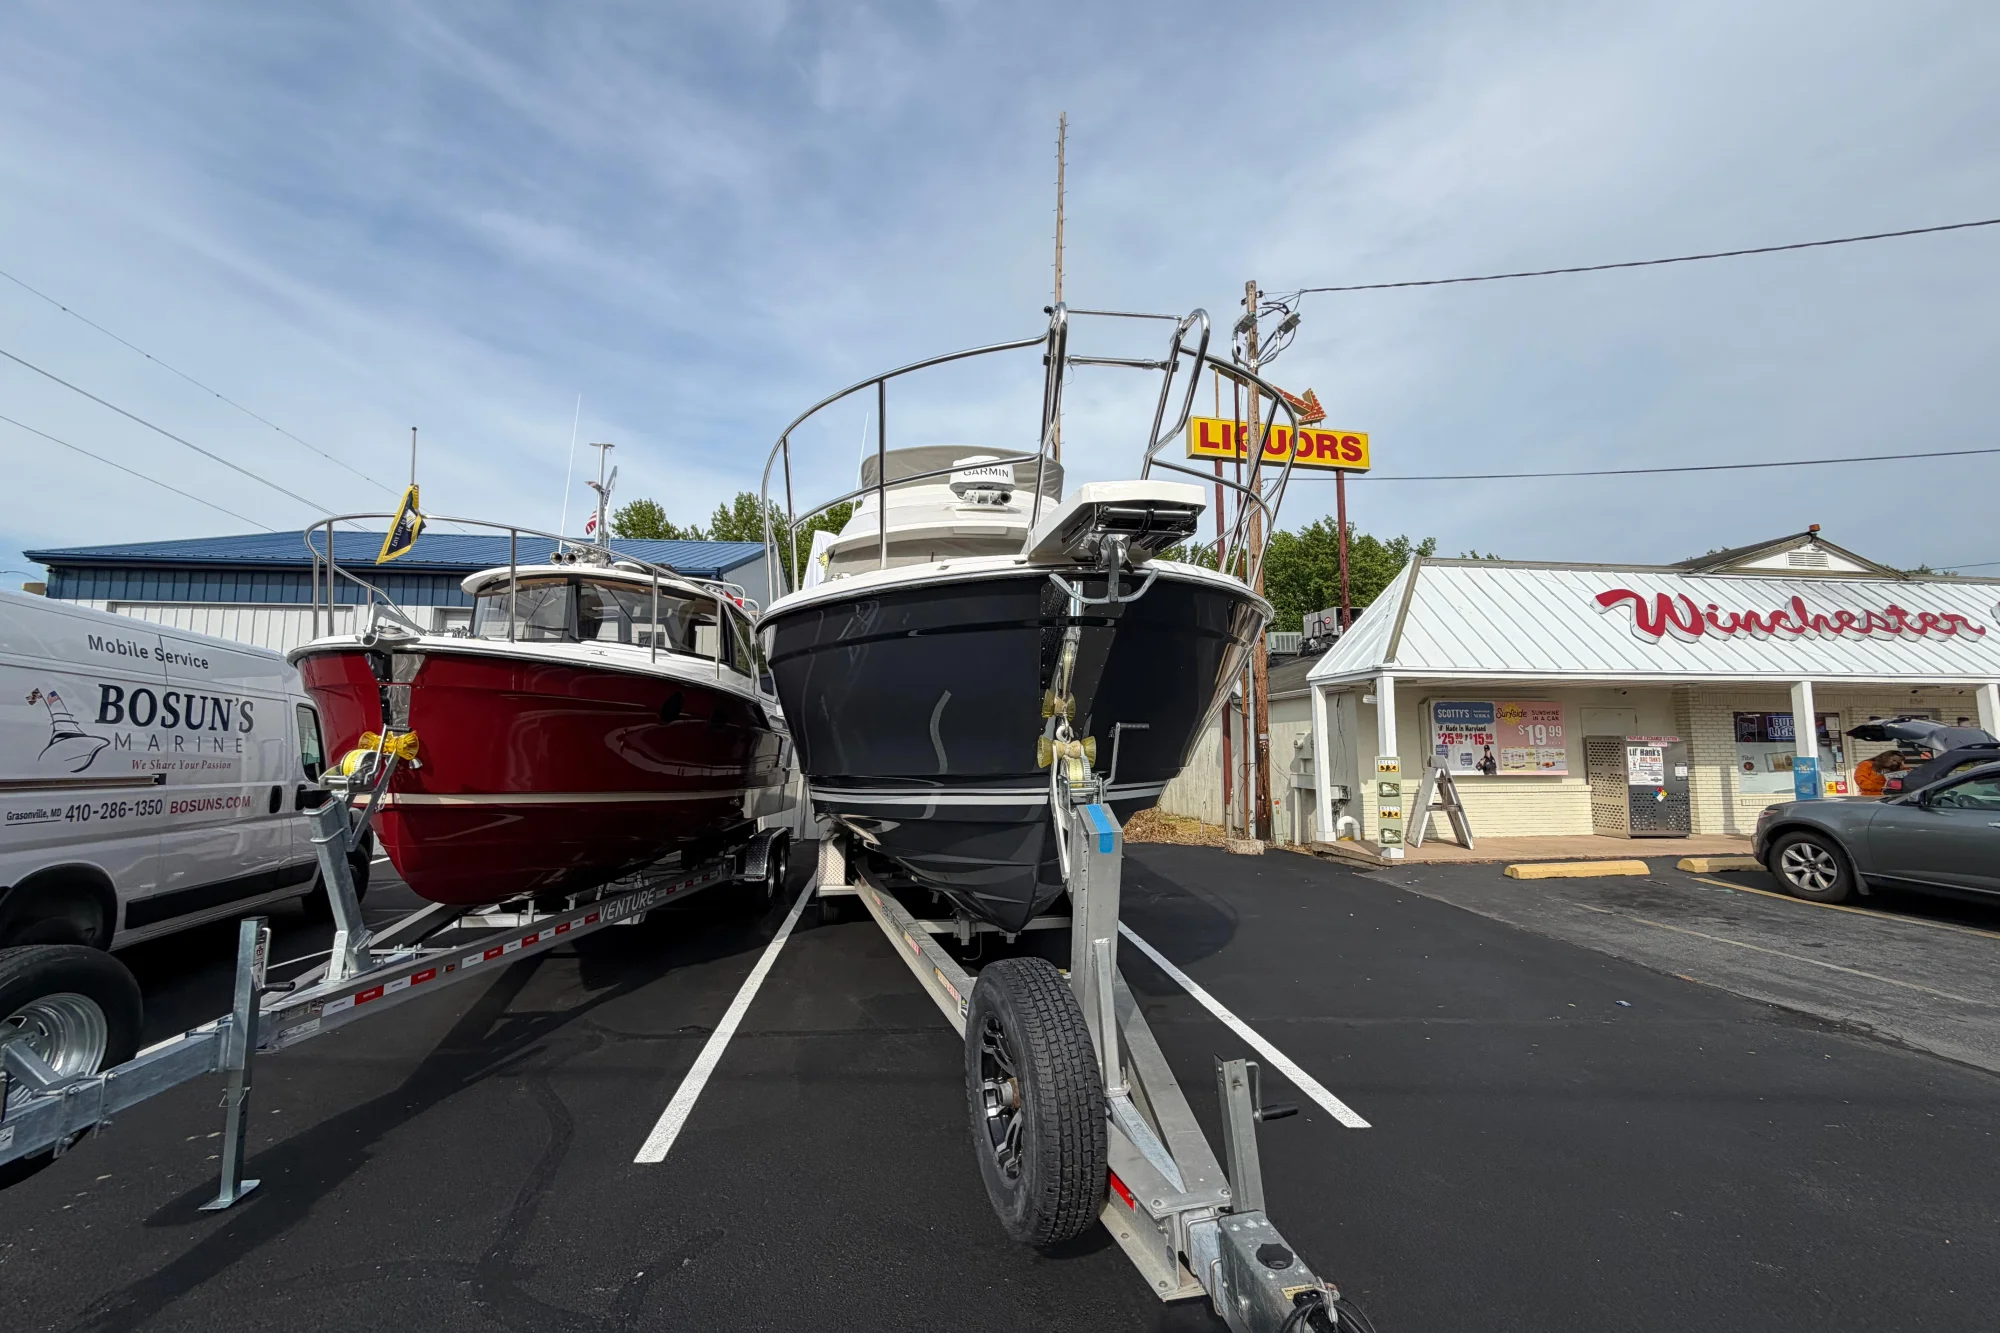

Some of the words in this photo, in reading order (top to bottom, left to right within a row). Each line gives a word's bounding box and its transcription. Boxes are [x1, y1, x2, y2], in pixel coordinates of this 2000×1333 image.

[963, 467, 1009, 478] GARMIN
[1591, 588, 1988, 643] Winchester
[88, 634, 149, 659] Mobile
[154, 647, 209, 669] Service
[95, 683, 254, 733] BOSUN'S
[1437, 709, 1470, 718] SCOTTY'S
[1496, 708, 1528, 719] Surfside
[1773, 718, 1795, 727] BUD
[114, 732, 243, 753] MARINE
[1640, 748, 1661, 756] Hank's
[131, 759, 148, 770] We
[149, 759, 176, 771] Share
[178, 760, 199, 770] Your
[201, 760, 231, 770] Passion
[7, 809, 49, 821] Grasonville,
[50, 808, 62, 817] MD
[65, 799, 163, 822] 410-286-1350
[169, 796, 251, 814] BOSUNS.COM
[599, 887, 656, 923] VENTURE
